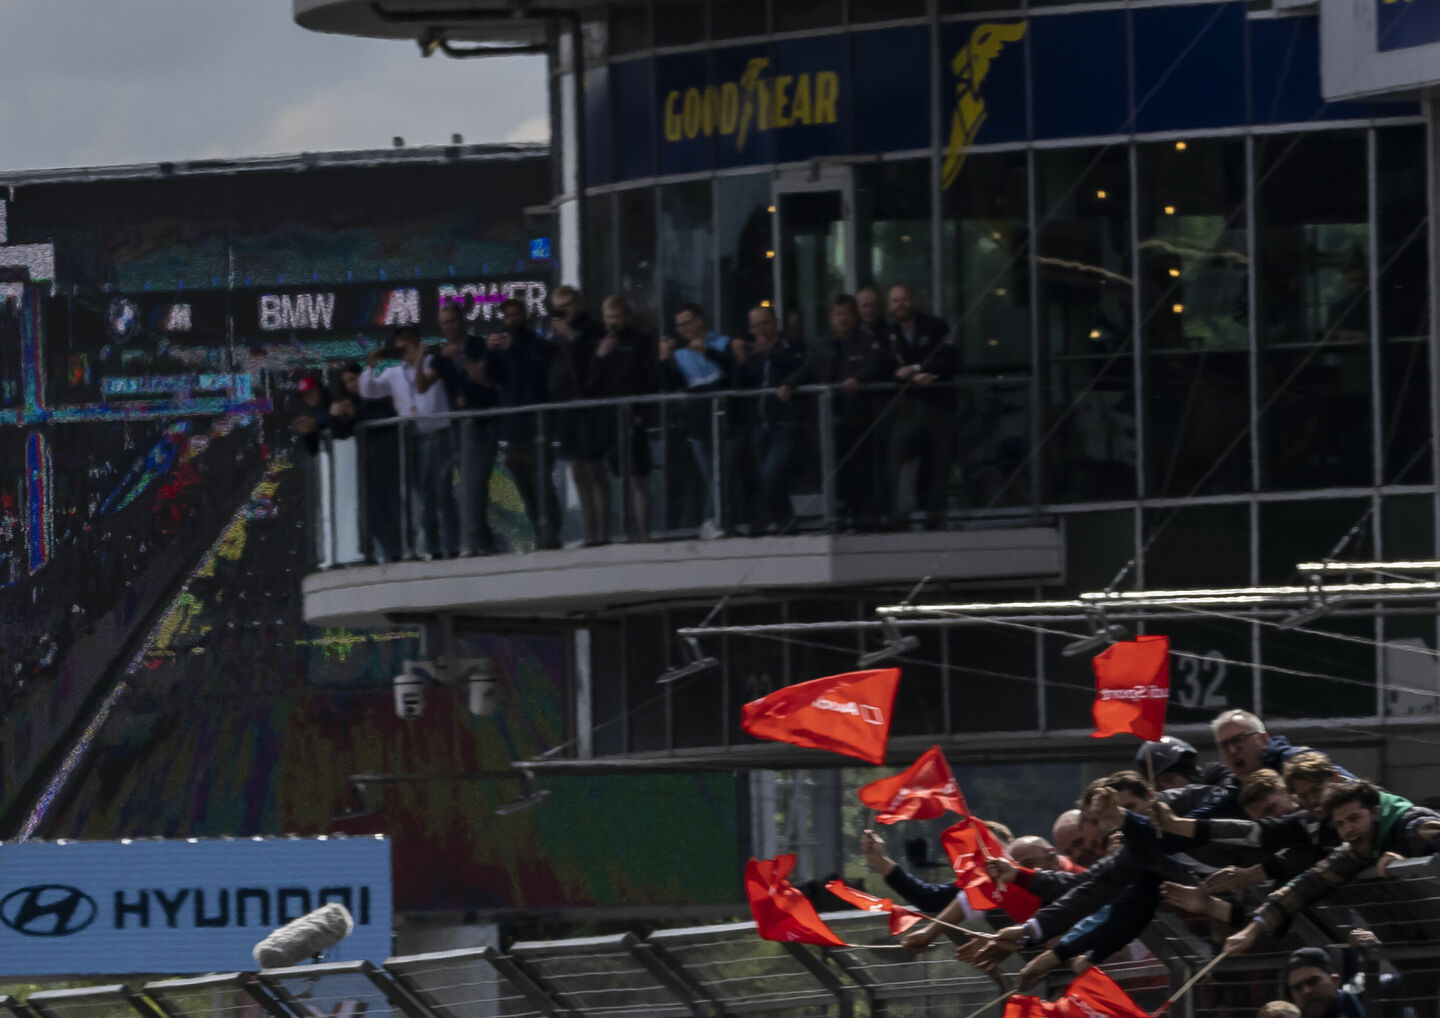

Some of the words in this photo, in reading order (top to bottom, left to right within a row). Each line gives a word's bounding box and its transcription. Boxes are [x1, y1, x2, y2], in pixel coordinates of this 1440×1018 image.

[664, 58, 840, 148] GOODYEAR
[260, 293, 335, 331] BMW
[1176, 650, 1228, 708] 32
[115, 886, 371, 929] HYUNDAI
